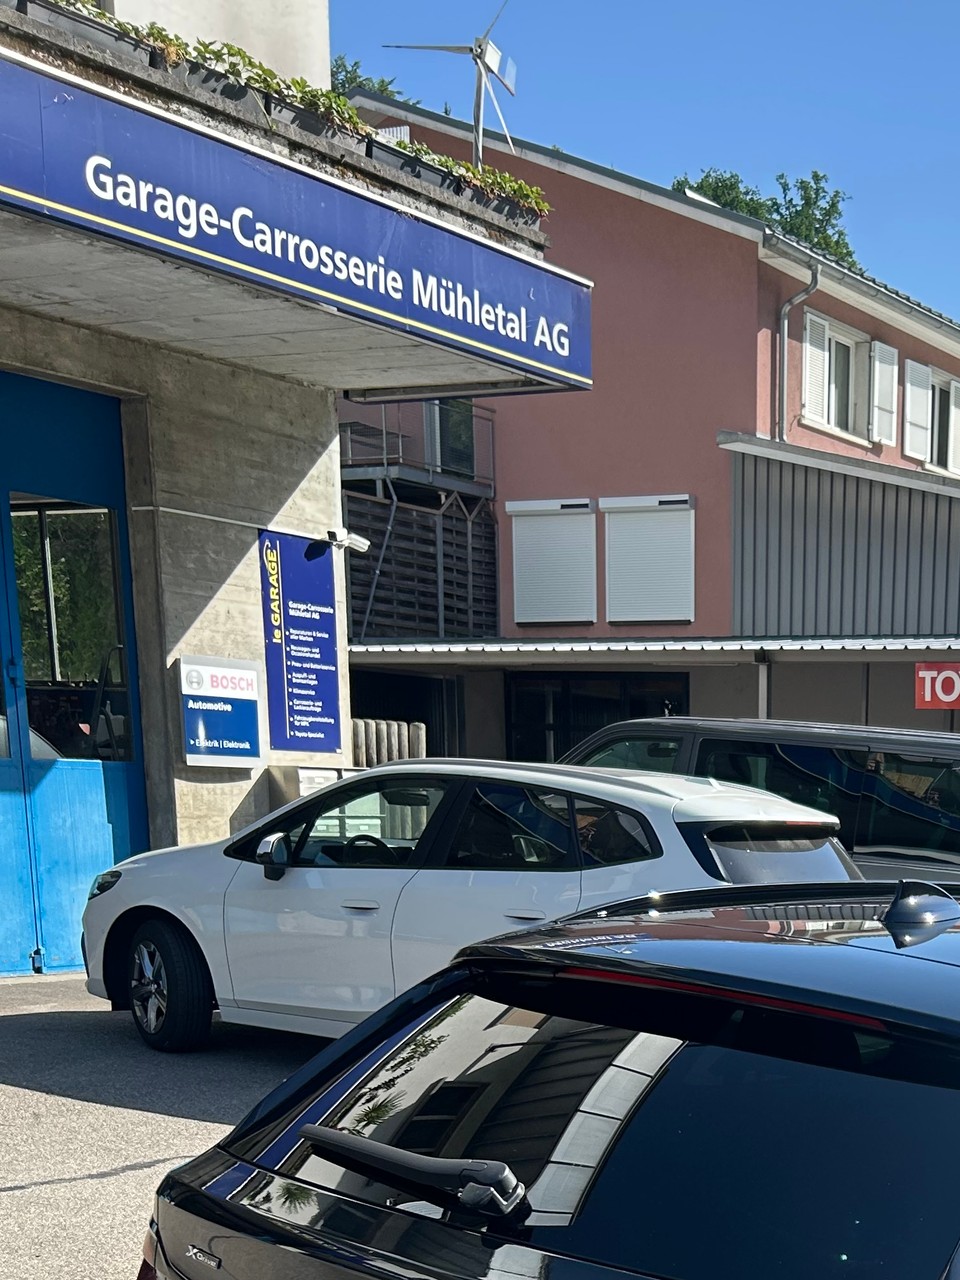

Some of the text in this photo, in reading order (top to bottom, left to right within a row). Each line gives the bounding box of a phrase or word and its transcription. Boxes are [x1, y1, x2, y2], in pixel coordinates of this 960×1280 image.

[84, 155, 570, 357] Garage-Carrosserie Mühletal AG
[266, 548, 282, 644] le GARAGE
[210, 674, 254, 691] BOSCH
[187, 700, 232, 712] Automotive
[223, 740, 251, 749] Elektronik
